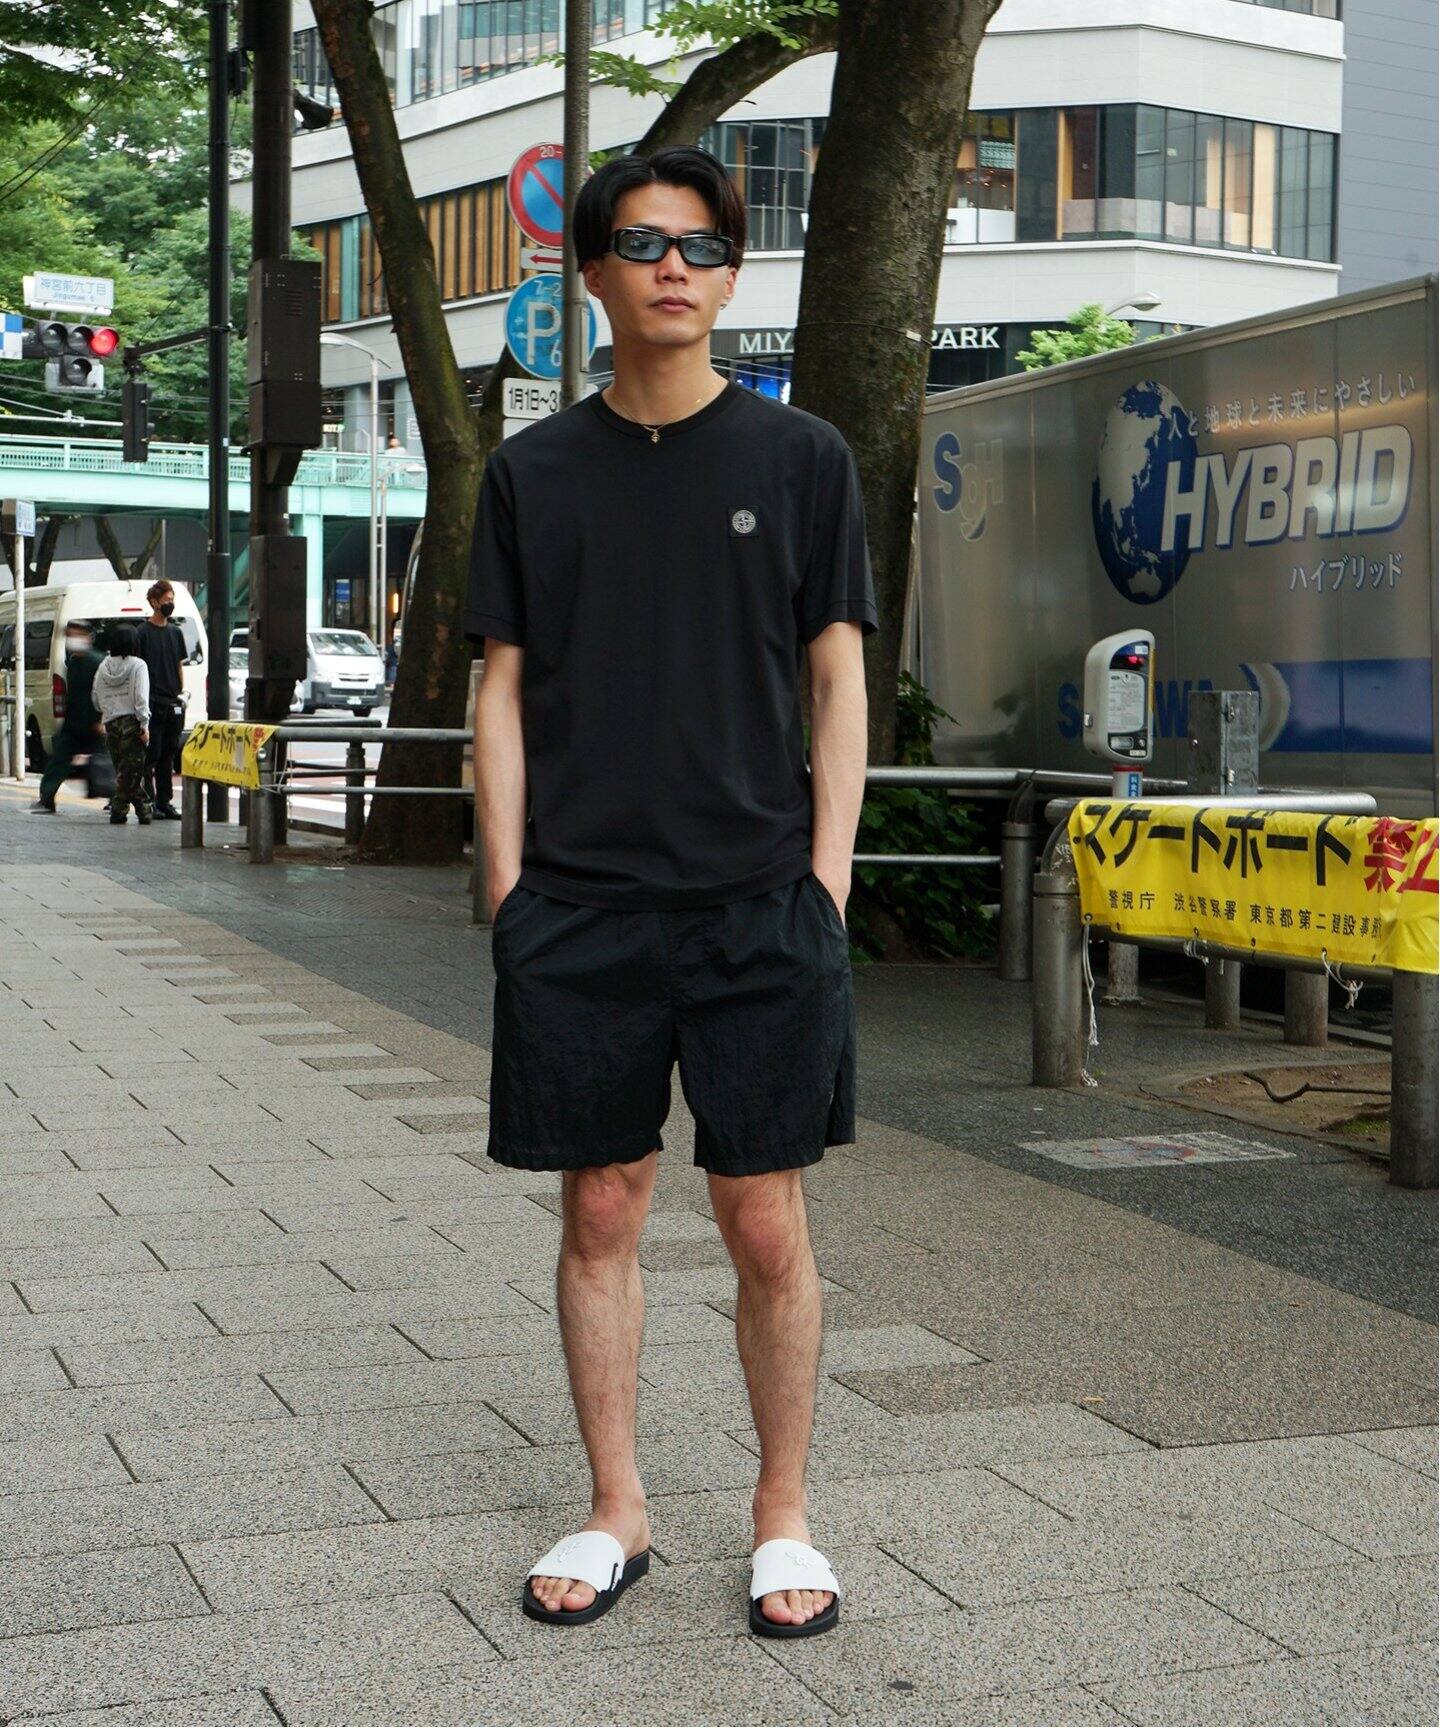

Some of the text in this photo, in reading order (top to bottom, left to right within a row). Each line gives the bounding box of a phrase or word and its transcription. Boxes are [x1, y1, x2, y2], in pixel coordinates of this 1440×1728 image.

[540, 146, 563, 157] 20-
[533, 280, 562, 297] 7-2
[527, 301, 561, 365] P
[739, 331, 794, 354] MIY
[551, 339, 562, 367] 6
[508, 387, 561, 413] 1月1日~3
[1168, 372, 1416, 442] 人と地球と未来にやさしい
[1160, 423, 1414, 553] HYBRID
[1289, 552, 1404, 593] ハイブリッド
[1108, 889, 1156, 911] 警視庁
[1173, 892, 1238, 922] 渋谷警察署
